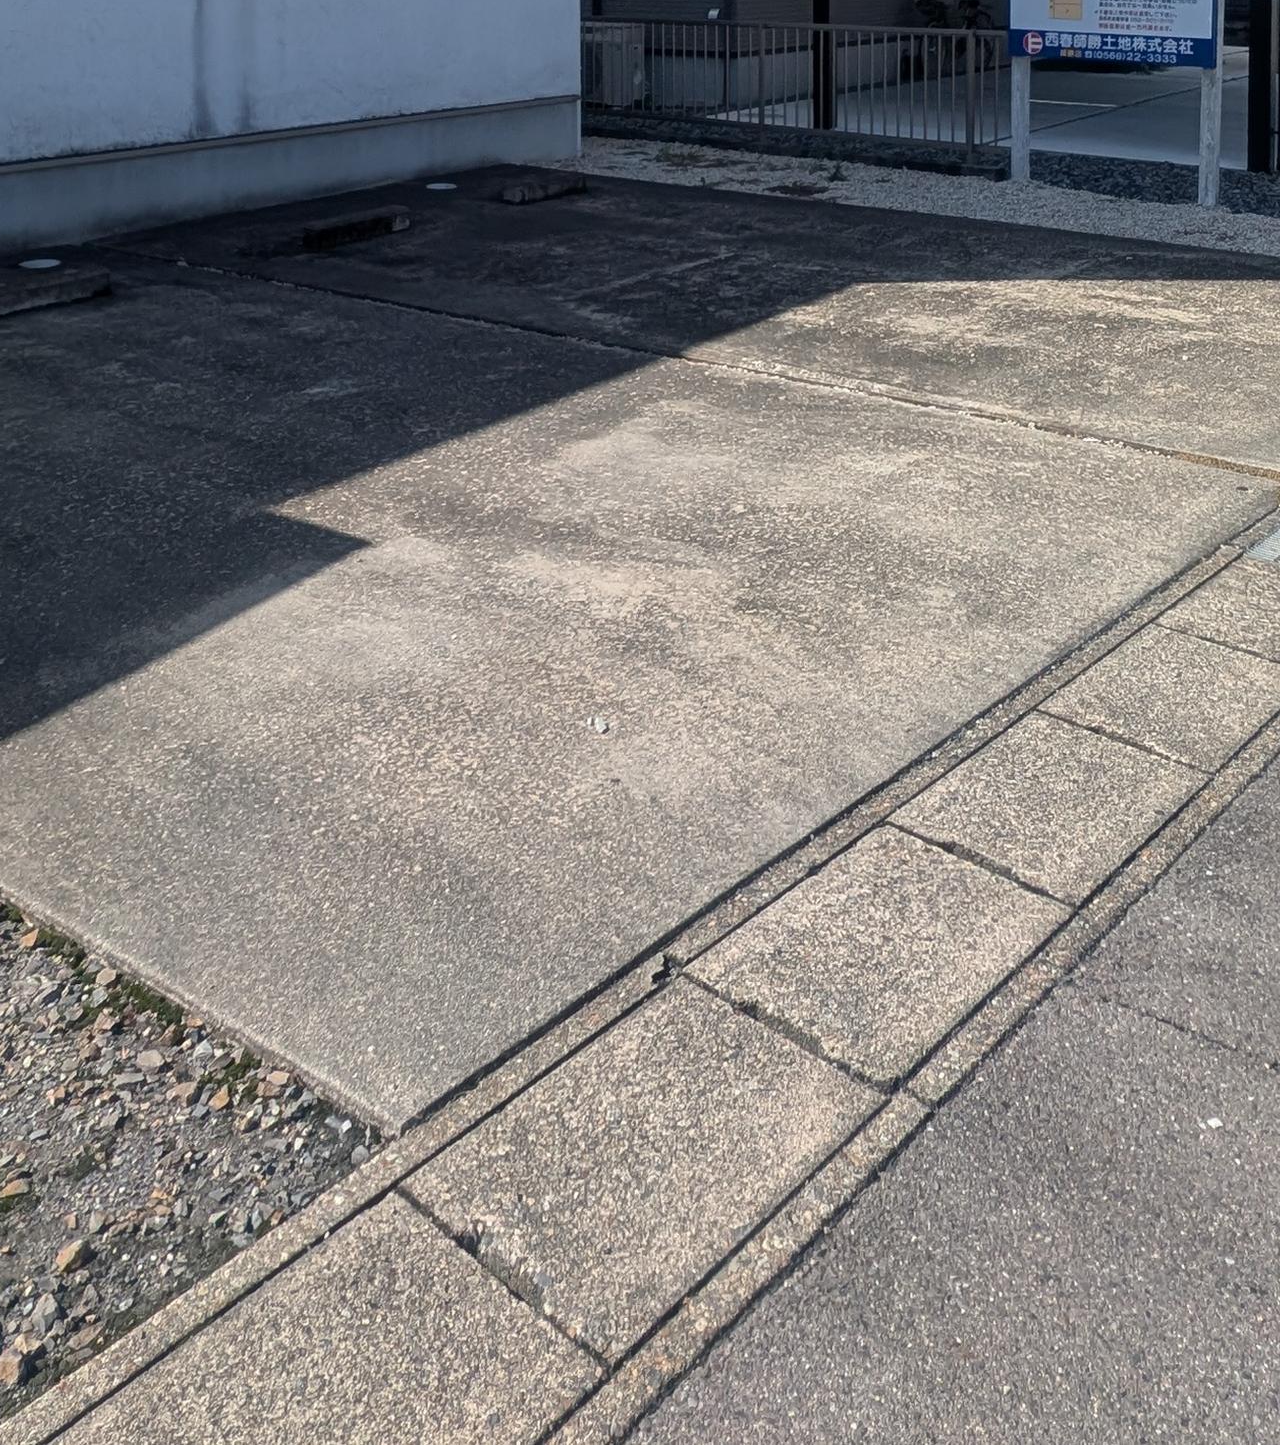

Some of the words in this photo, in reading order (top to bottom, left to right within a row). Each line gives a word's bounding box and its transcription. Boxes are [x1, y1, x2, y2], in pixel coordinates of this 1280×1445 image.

[1045, 32, 1194, 55] 西春師勝土地株式会社
